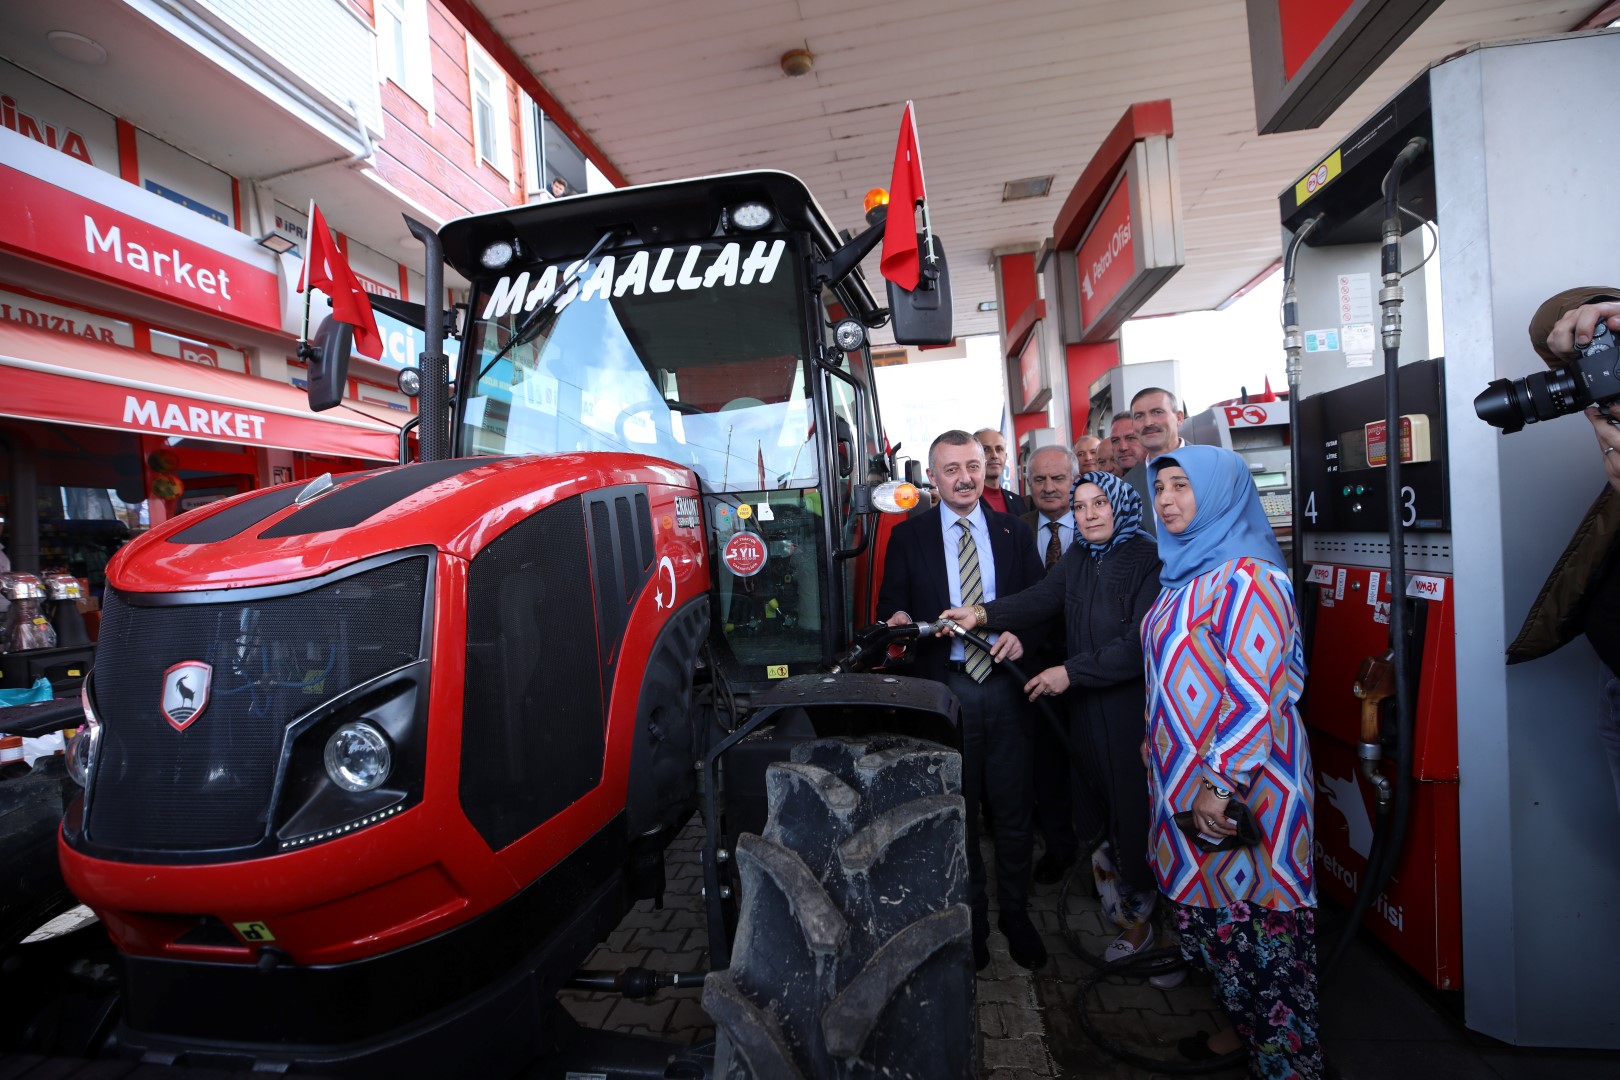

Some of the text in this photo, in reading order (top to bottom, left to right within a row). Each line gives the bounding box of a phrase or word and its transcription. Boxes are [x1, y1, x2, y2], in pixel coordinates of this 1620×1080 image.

[84, 214, 231, 300] Market
[1093, 215, 1131, 285] Petrol Ofisi
[123, 395, 265, 439] MARKET
[1304, 491, 1318, 524] 4
[1401, 486, 1417, 527] 3
[1314, 840, 1357, 893] Petrol
[1371, 892, 1403, 932] fisi
